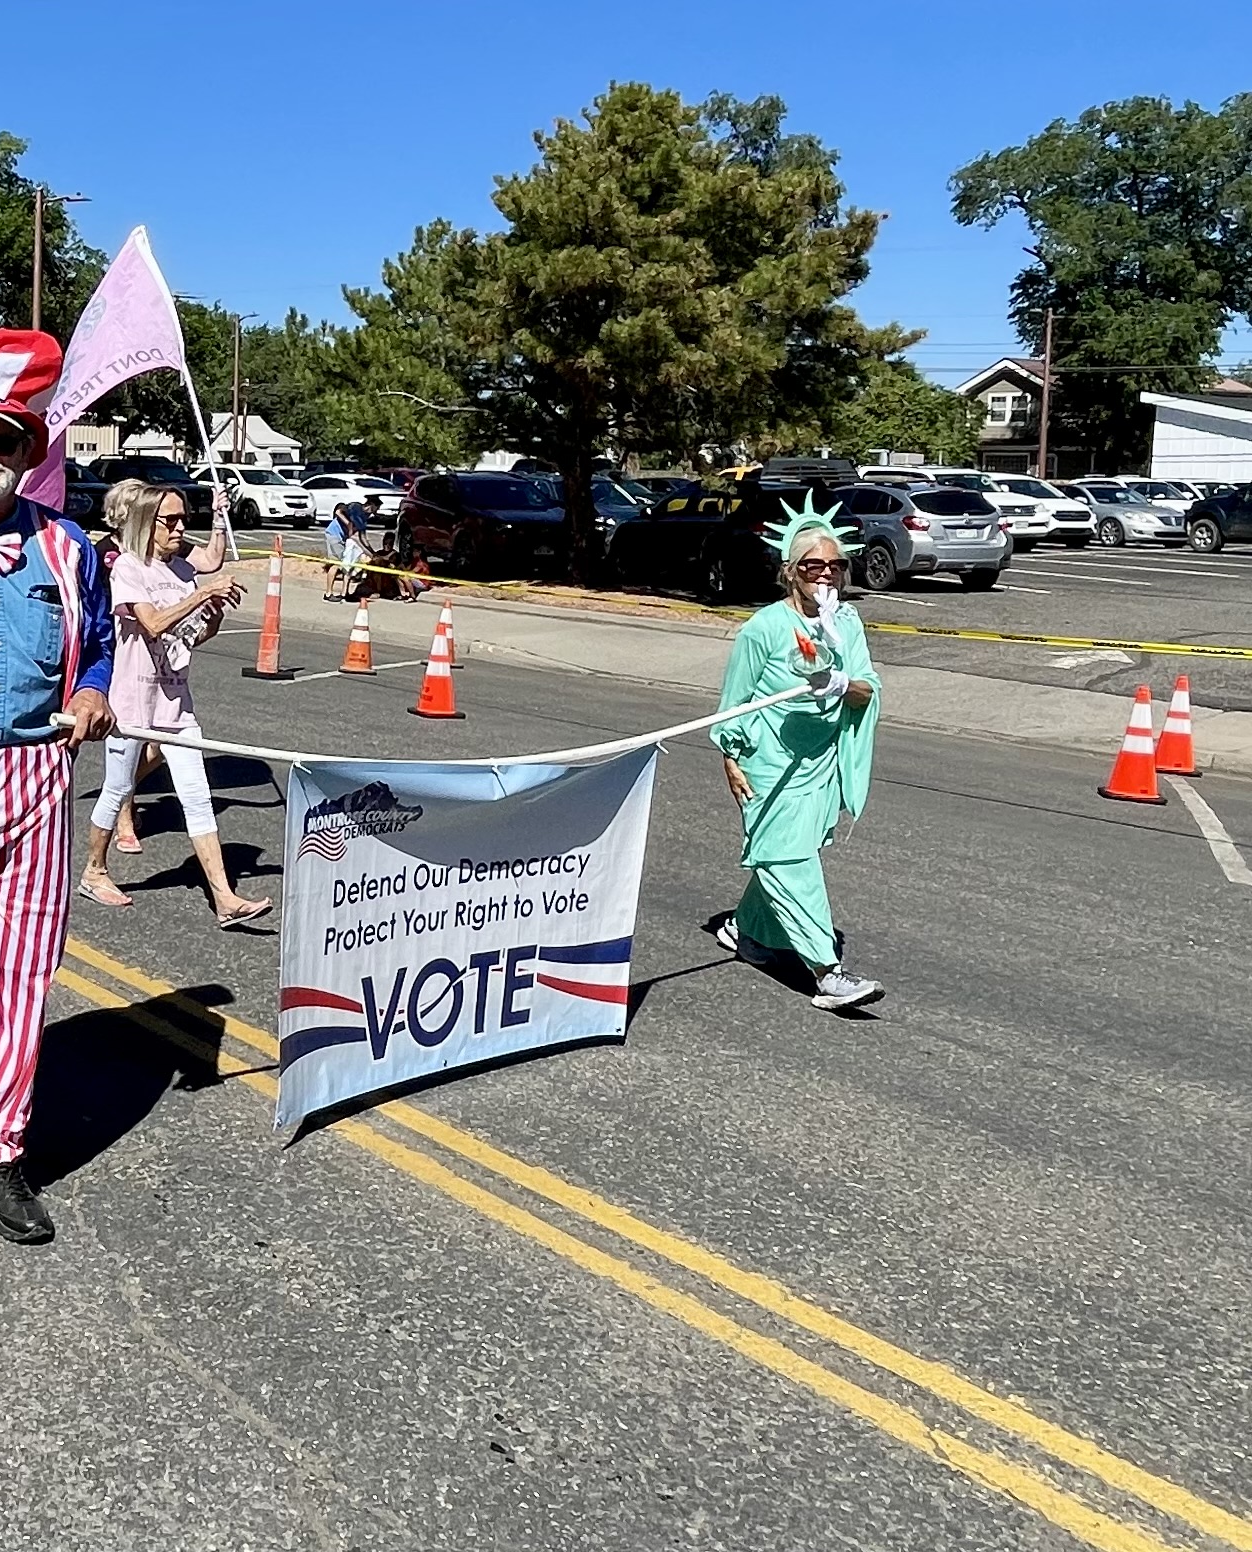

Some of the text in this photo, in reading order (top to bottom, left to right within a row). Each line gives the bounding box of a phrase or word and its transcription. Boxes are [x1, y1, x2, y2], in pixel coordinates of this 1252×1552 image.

[308, 810, 419, 832] MONTROSE COUNTY
[344, 821, 406, 840] DEMOCRATS
[333, 853, 591, 908] Defend Our Democracy
[324, 887, 590, 956] Protect Your Right to Vote
[361, 944, 538, 1060] VOTE
